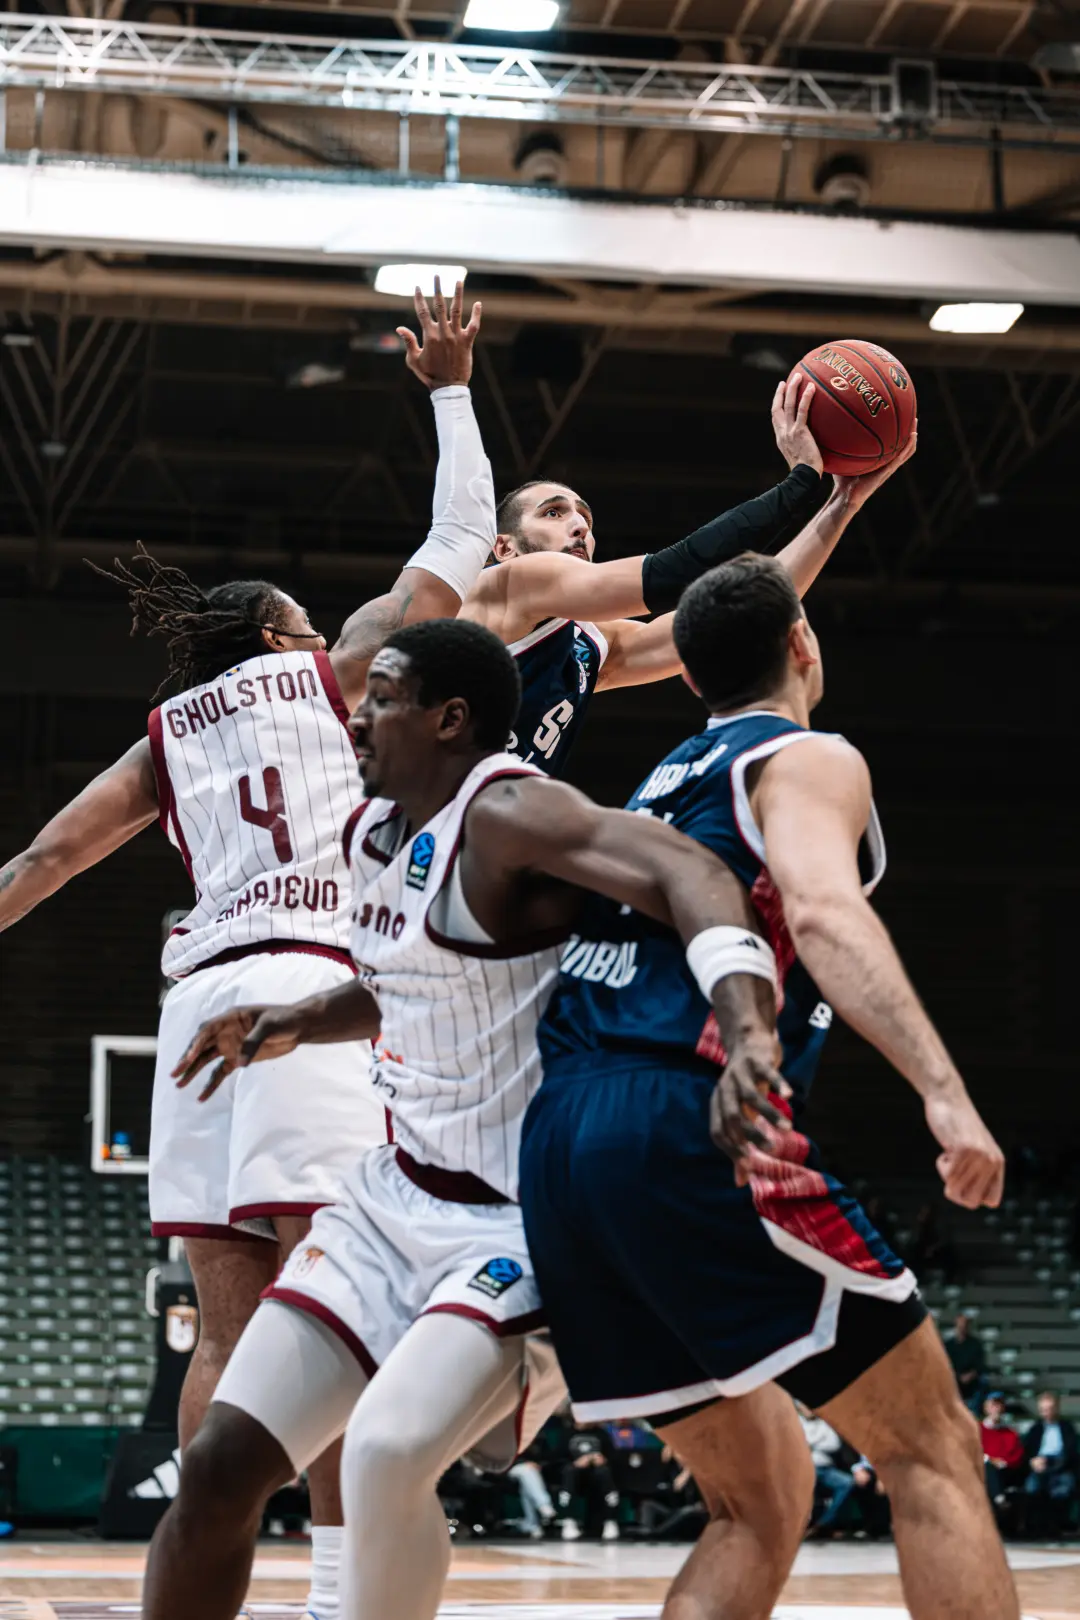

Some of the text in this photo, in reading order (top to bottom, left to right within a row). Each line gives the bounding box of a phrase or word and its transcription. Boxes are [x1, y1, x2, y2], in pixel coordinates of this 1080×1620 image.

[814, 347, 889, 417] SPALDING
[166, 668, 318, 739] GHOLSTON
[238, 766, 293, 863] 4
